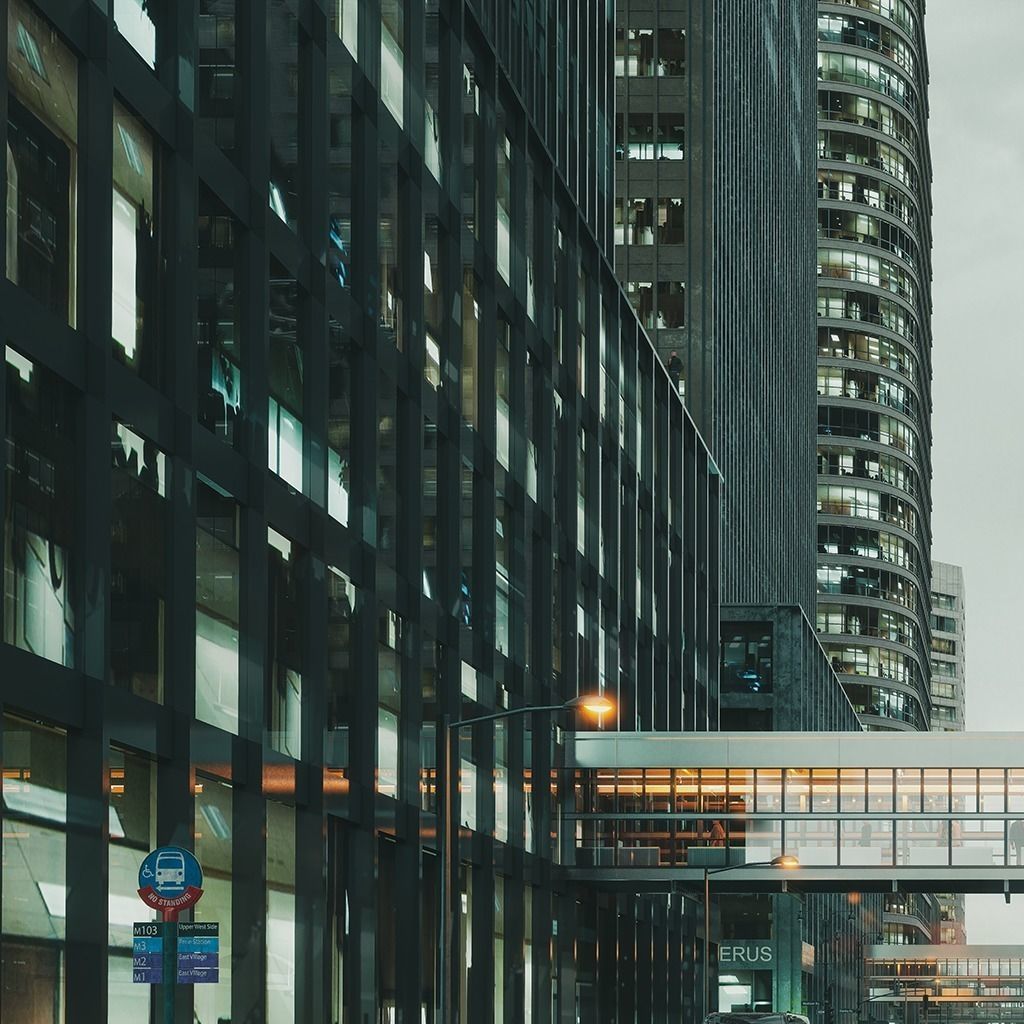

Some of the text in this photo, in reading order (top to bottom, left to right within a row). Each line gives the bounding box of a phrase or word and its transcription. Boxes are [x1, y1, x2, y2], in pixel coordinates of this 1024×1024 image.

[148, 893, 192, 907] NO STANDING
[134, 926, 158, 935] M103
[134, 941, 146, 950] M3
[720, 946, 772, 961] ERUS
[134, 957, 146, 966] M2
[134, 973, 145, 982] M1
